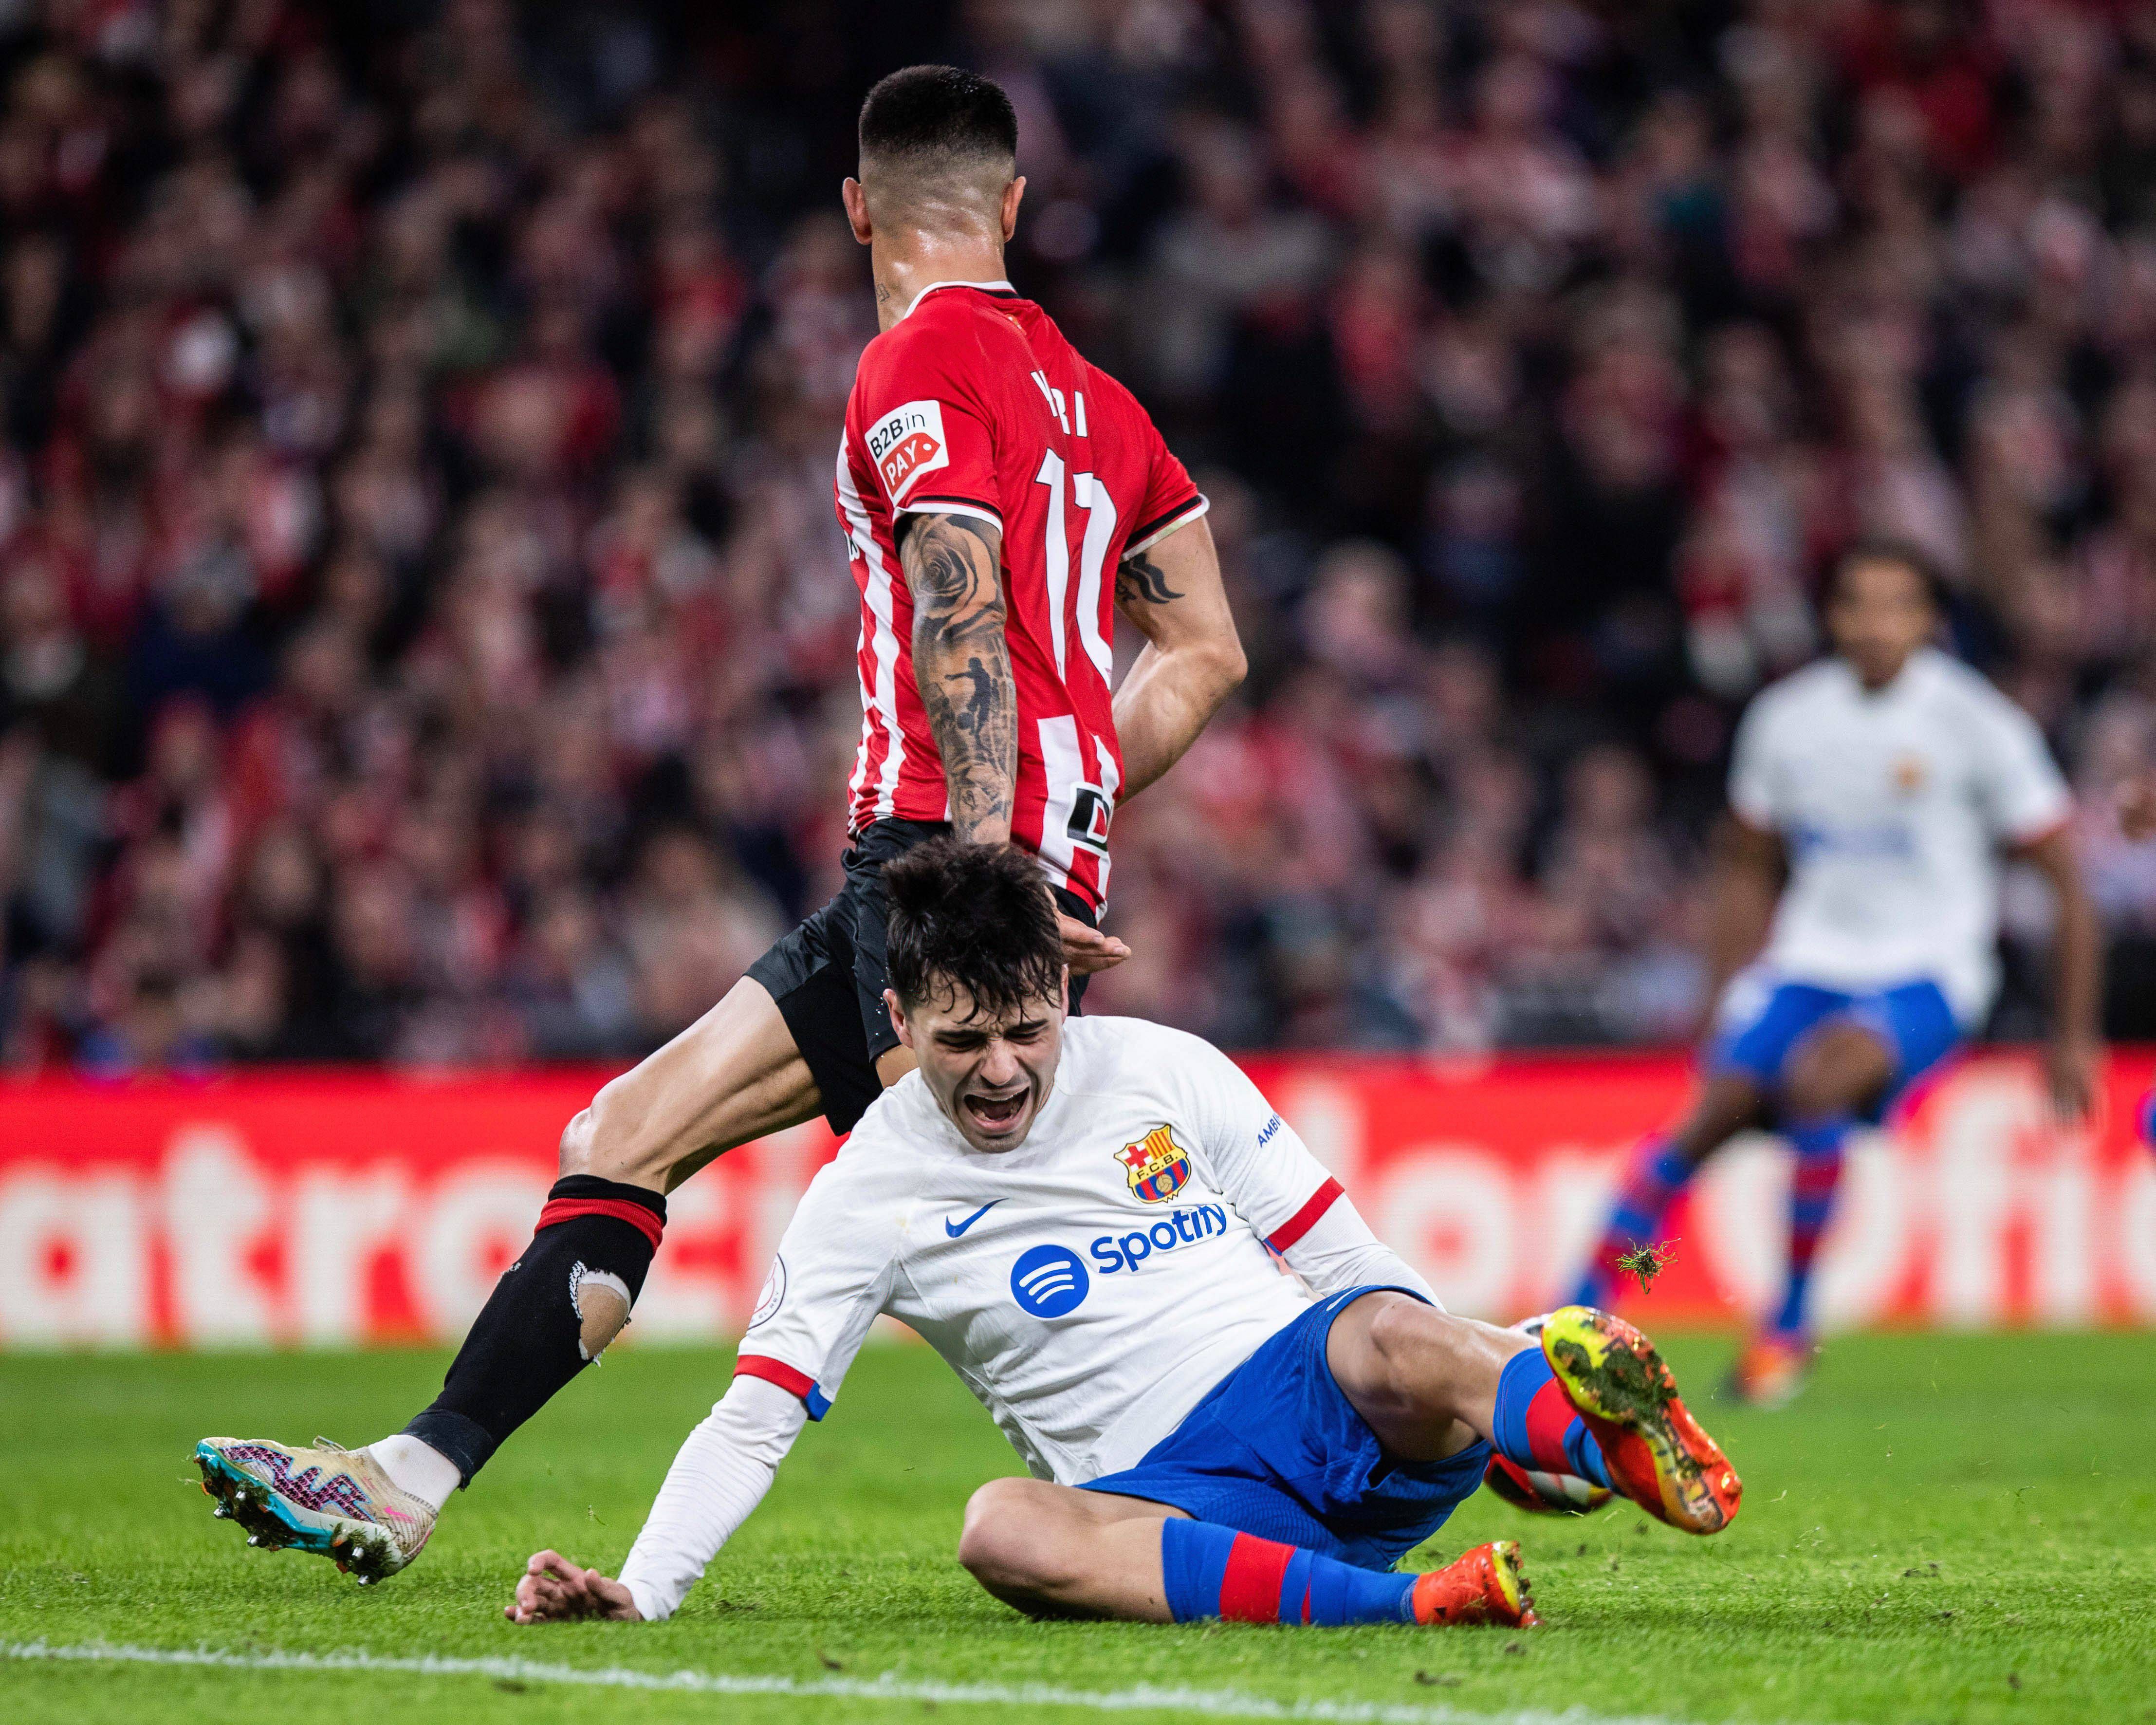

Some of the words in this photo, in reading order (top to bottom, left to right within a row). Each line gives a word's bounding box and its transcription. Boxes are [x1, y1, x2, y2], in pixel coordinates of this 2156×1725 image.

[869, 412, 926, 460] B2Bin
[885, 439, 918, 487] PAY
[1033, 446, 1118, 691] 17
